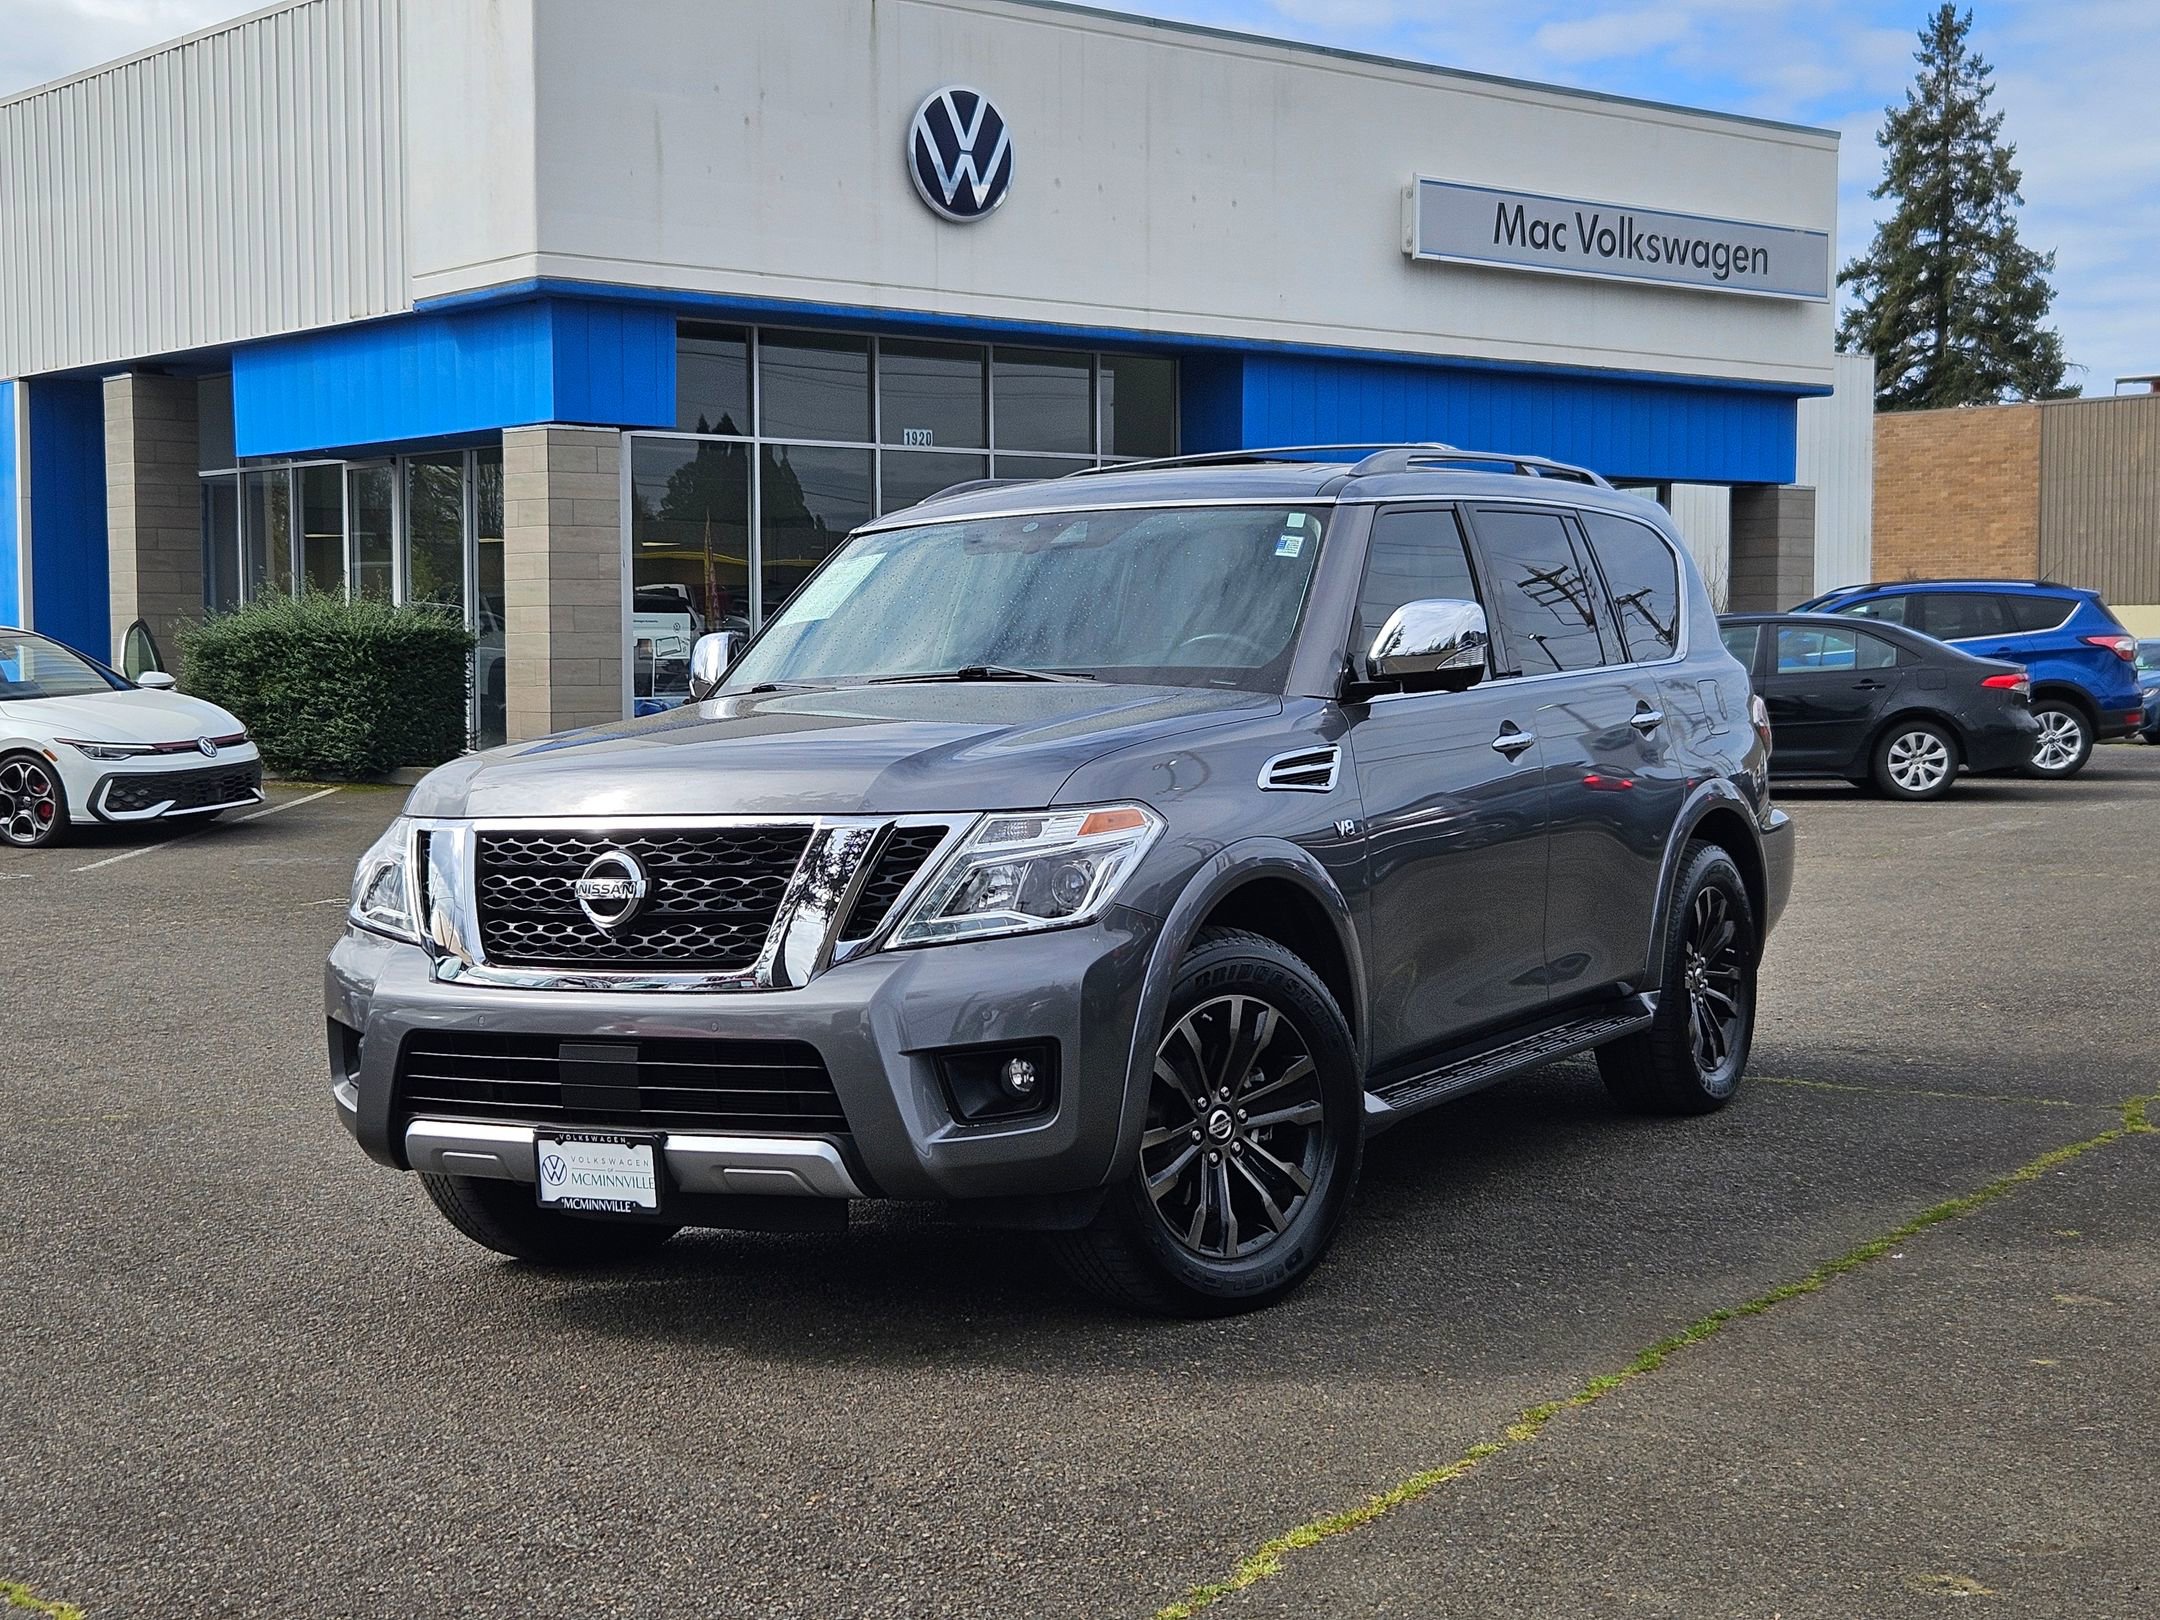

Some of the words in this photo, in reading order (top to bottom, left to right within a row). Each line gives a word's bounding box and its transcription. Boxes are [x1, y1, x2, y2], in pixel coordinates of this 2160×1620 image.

[1492, 201, 1567, 253] Mac
[1574, 211, 1769, 281] Volkswagen
[905, 431, 932, 446] 1920
[1334, 819, 1355, 837] V8
[577, 884, 635, 895] NISSAN
[559, 1133, 627, 1144] VOLKSWAGEN
[570, 1155, 650, 1167] VOLKSWAGEN
[571, 1172, 656, 1190] MCMINNVILLE
[562, 1198, 632, 1213] MCMINNVILLE
